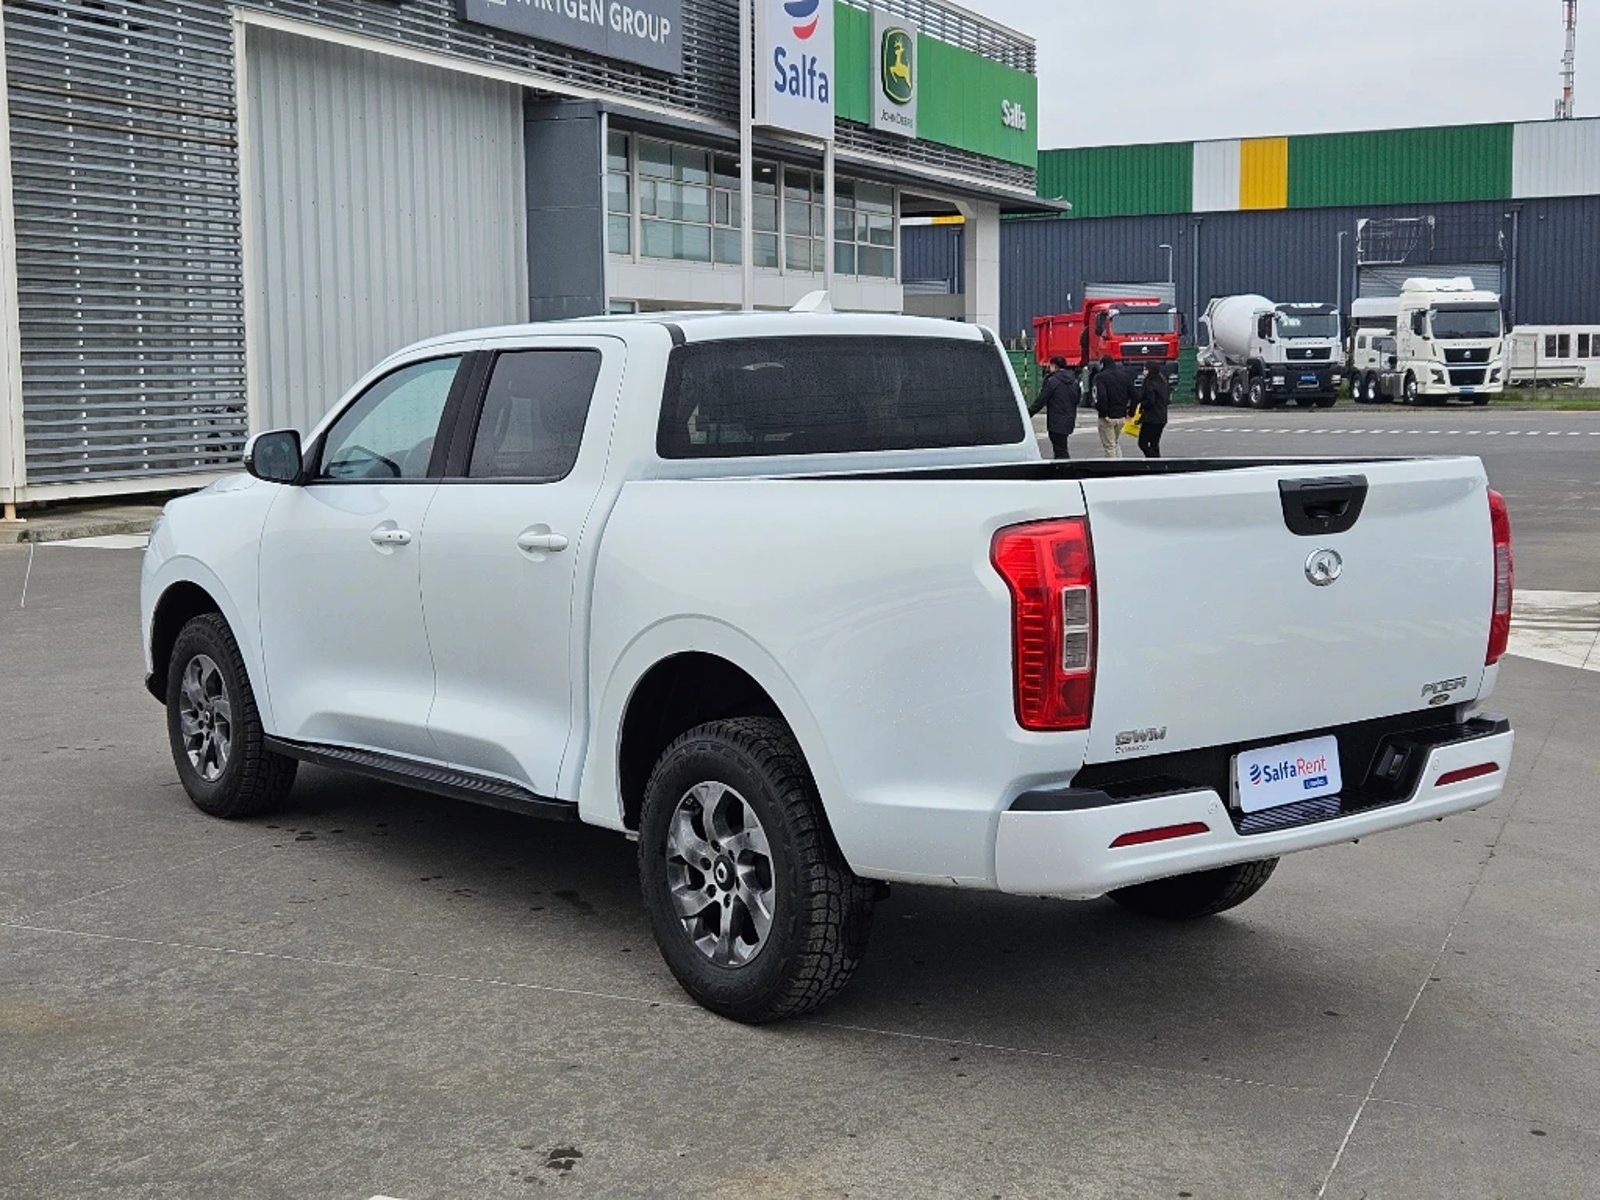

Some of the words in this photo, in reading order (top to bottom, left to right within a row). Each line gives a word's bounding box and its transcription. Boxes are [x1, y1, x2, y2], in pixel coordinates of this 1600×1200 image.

[609, 2, 671, 44] GROUP
[774, 46, 829, 104] Salfa
[1263, 755, 1327, 783] SalfaRent
